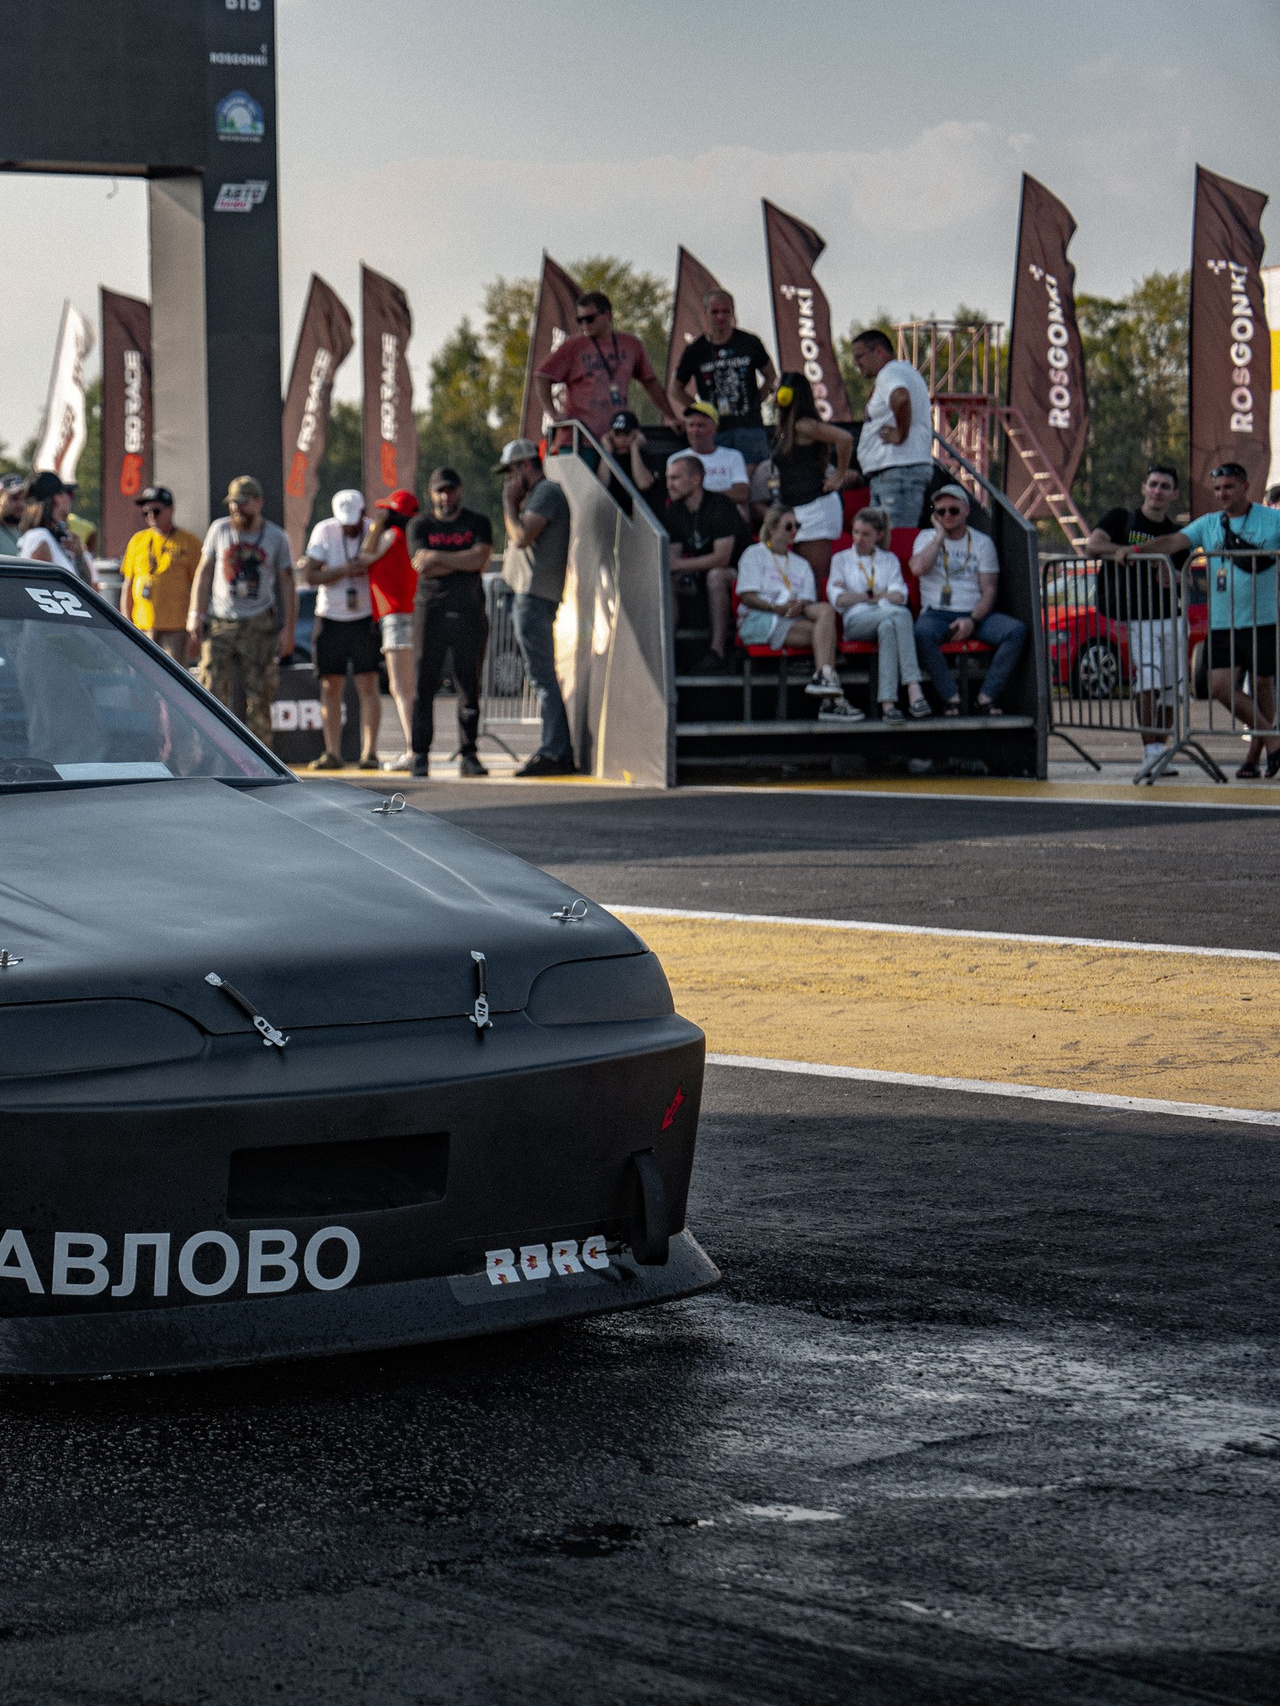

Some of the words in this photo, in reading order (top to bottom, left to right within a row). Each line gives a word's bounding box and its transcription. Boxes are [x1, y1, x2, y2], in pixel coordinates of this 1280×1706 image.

[796, 287, 834, 422] OSGONKI
[1045, 273, 1070, 429] ROSGONKI
[1229, 261, 1255, 433] ROSGONKI
[24, 587, 93, 618] 52
